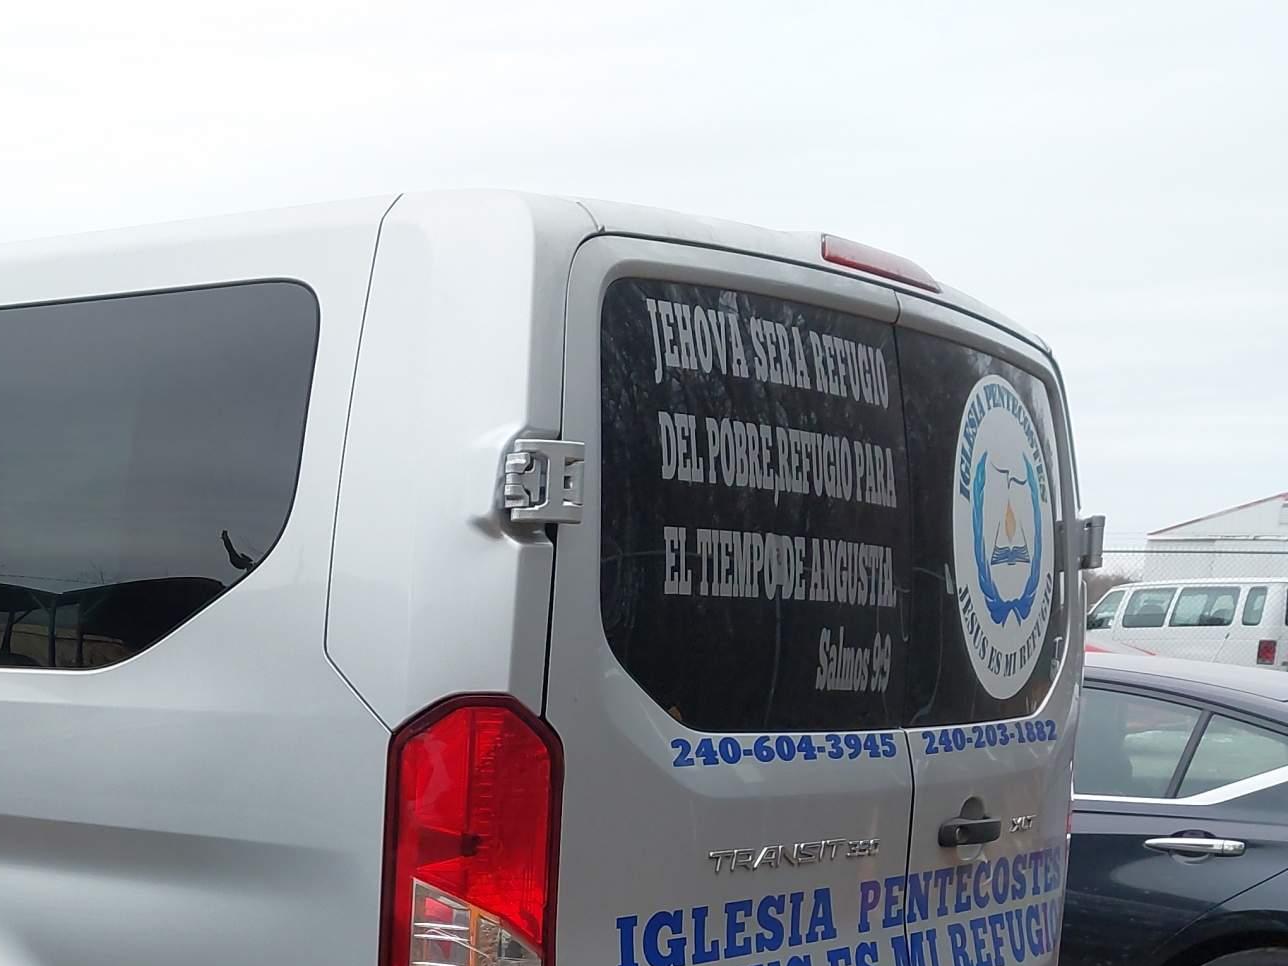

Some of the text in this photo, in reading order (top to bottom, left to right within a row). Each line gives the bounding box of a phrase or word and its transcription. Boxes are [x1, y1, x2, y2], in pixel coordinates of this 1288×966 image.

[809, 330, 890, 410] REFUGIO
[658, 411, 705, 483] DEL
[853, 440, 898, 508] PARA
[959, 391, 987, 504] IGLESIA
[664, 526, 693, 596] EL
[815, 626, 871, 692] Salmos
[958, 572, 1053, 677] JESUS ES MI REFUGIO
[670, 719, 1057, 769] 240-604-3945 240-203-1882
[709, 837, 847, 873] TRANSIT
[857, 846, 1062, 934] PENTECOSTES
